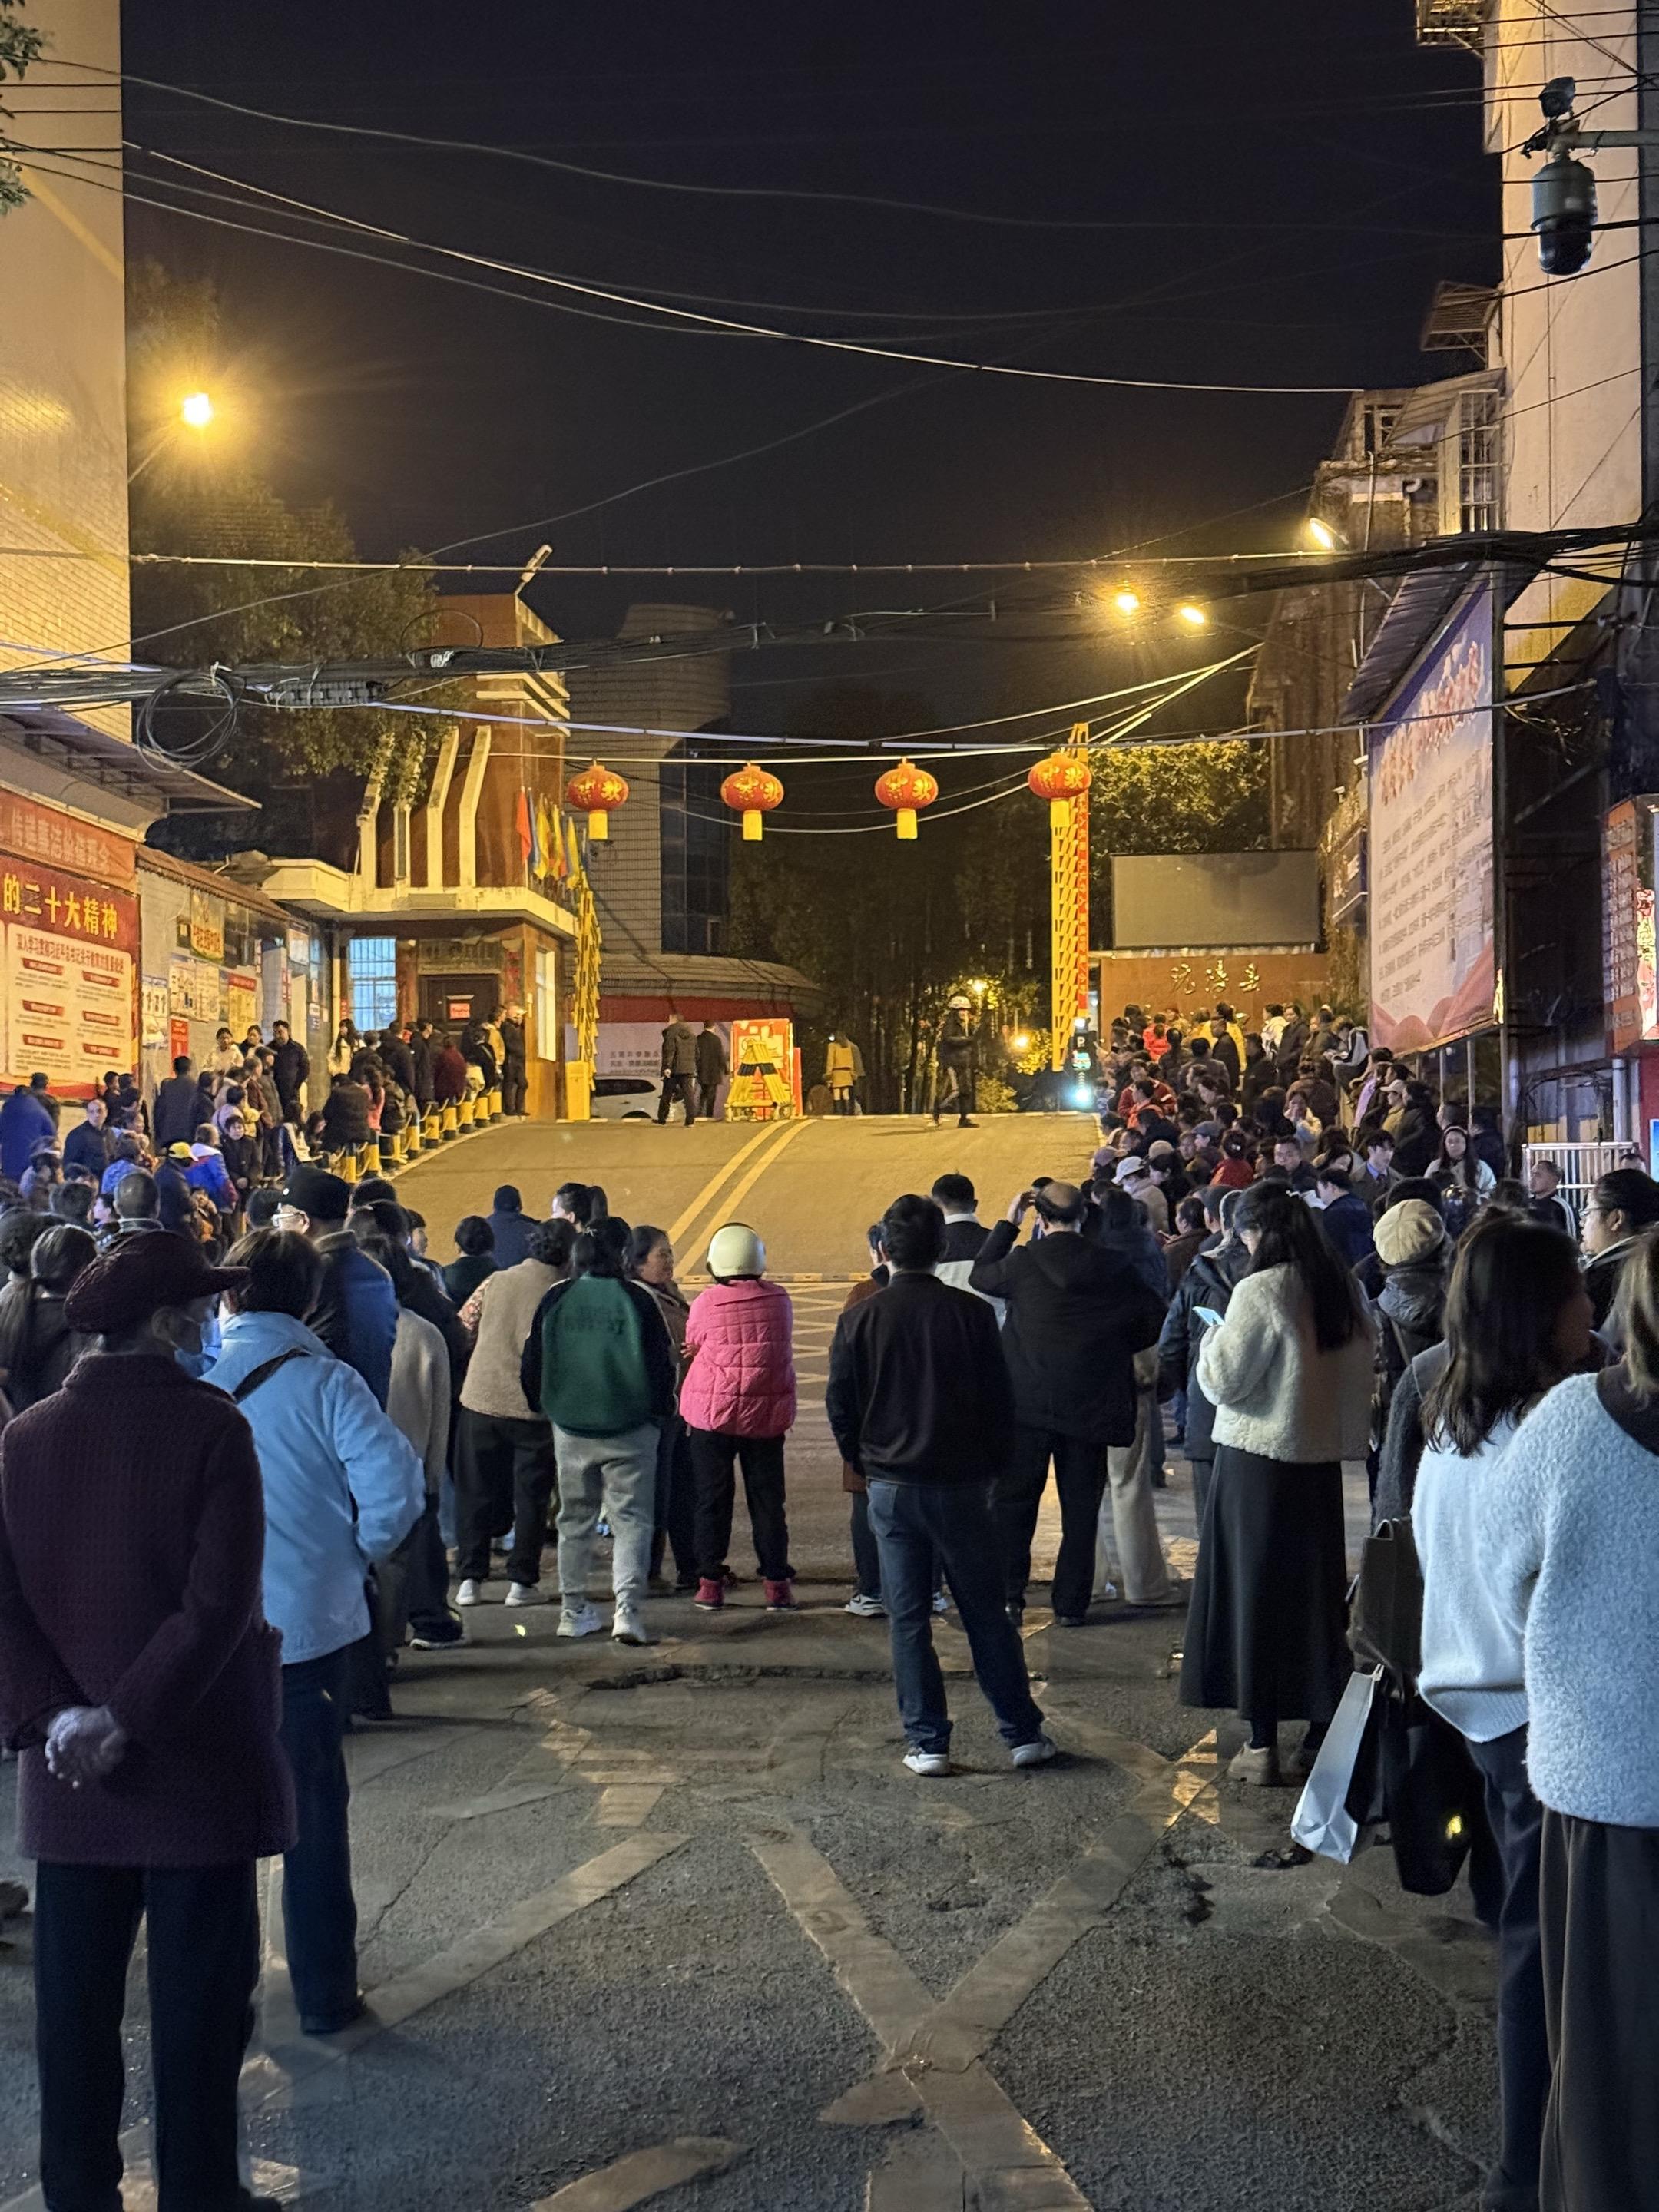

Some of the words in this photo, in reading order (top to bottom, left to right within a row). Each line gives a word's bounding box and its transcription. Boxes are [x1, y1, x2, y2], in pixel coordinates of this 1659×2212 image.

[3, 872, 118, 939] 的二十大精神
